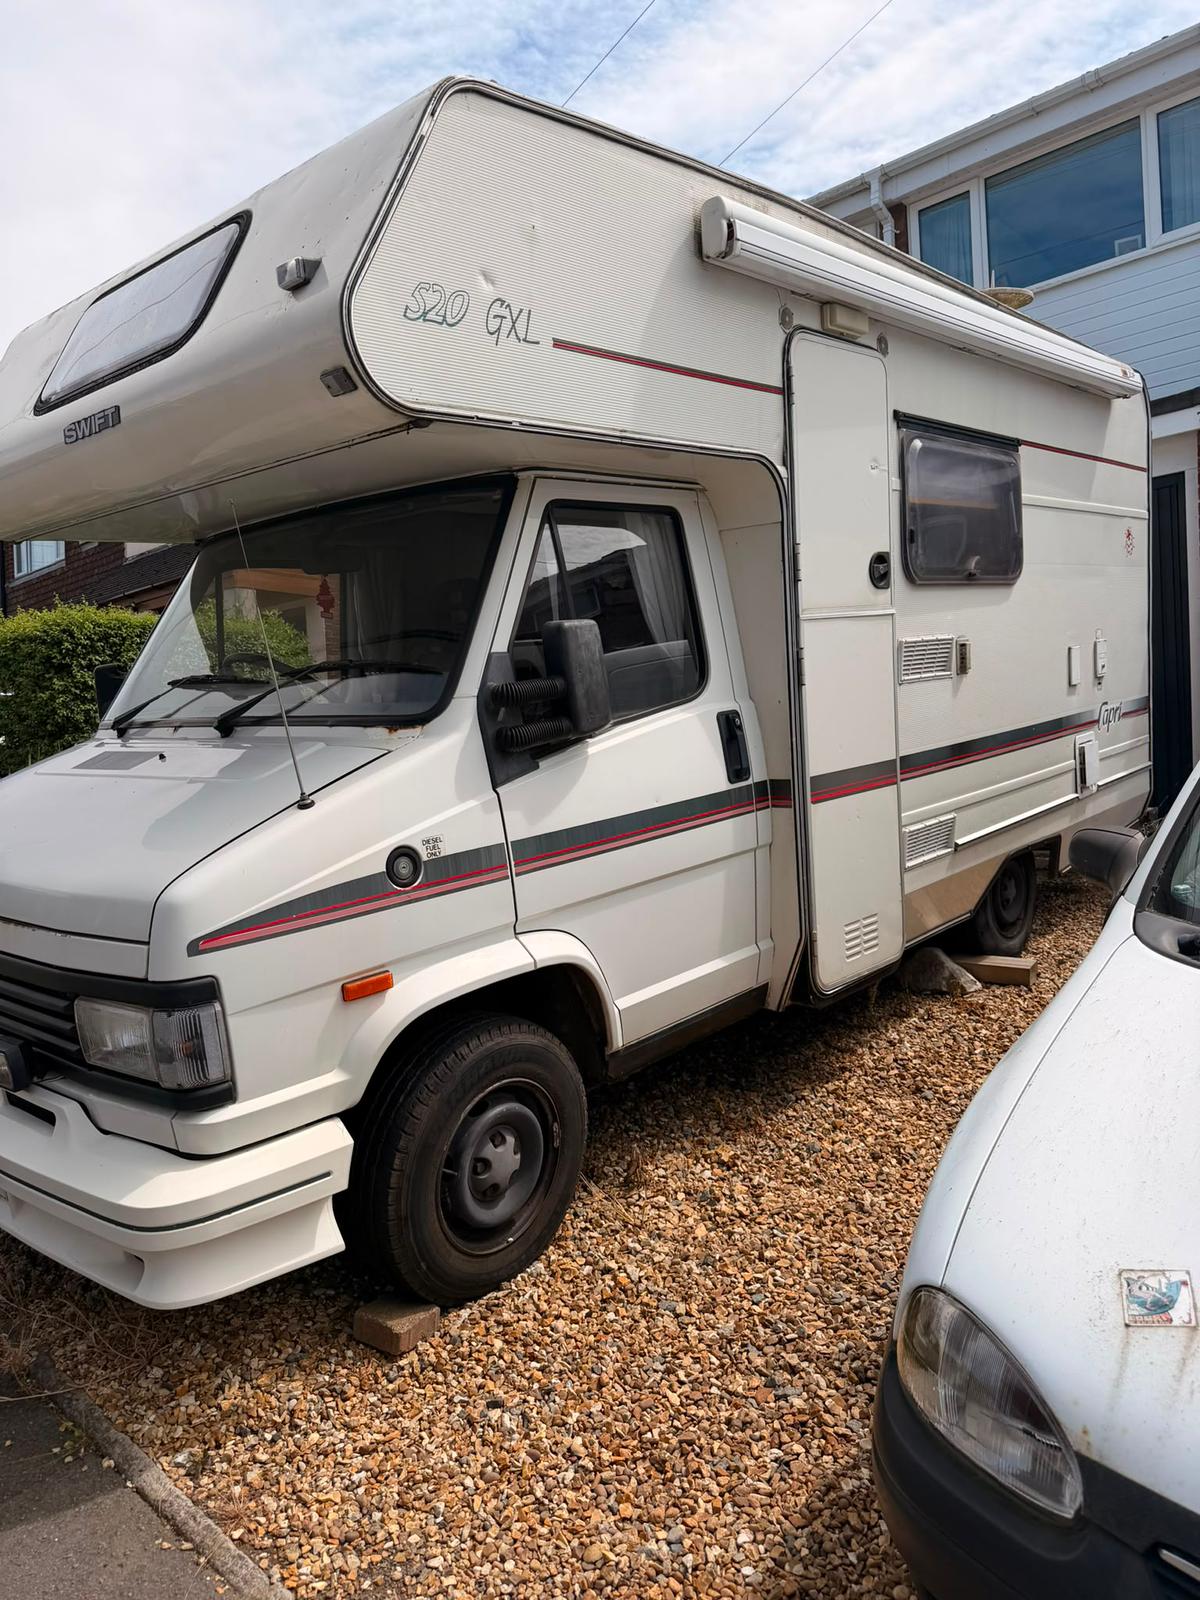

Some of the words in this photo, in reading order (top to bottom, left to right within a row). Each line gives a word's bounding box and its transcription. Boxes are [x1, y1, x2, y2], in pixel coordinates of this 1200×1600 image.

[486, 298, 540, 346] GXL
[64, 406, 118, 444] SWIFT
[1098, 701, 1122, 733] Capri
[422, 837, 442, 846] DIESEL
[426, 844, 440, 852] FUEL
[427, 850, 441, 858] ONLY
